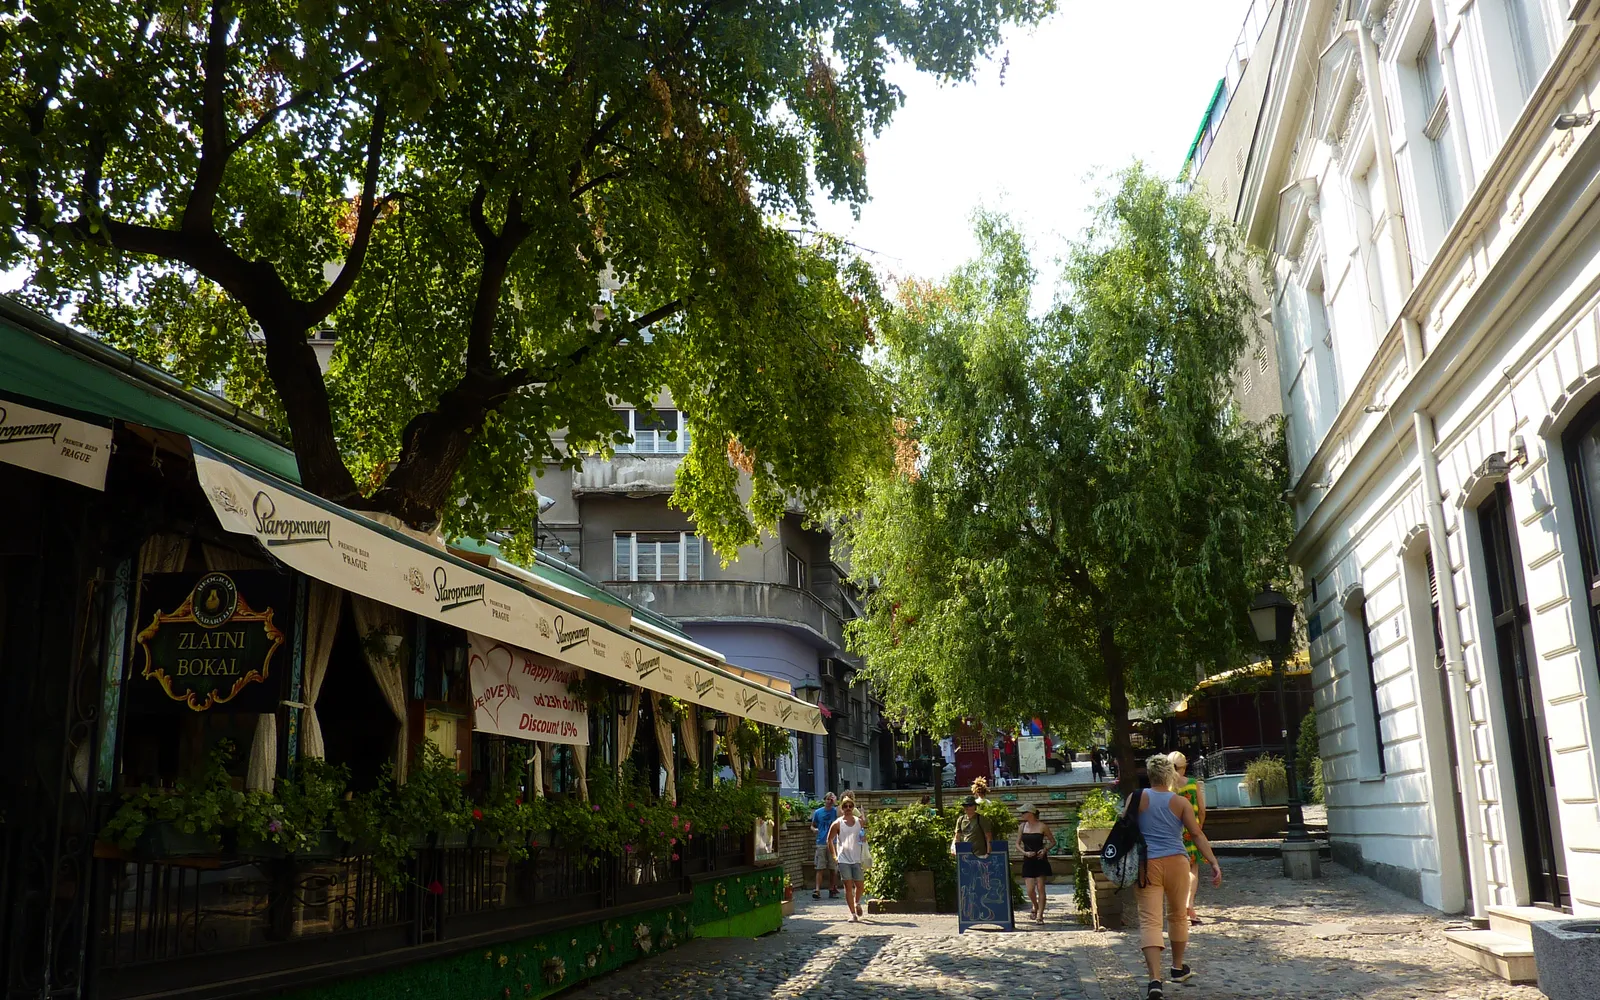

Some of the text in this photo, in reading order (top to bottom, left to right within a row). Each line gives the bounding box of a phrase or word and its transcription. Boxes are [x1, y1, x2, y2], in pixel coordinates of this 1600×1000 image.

[0, 407, 62, 444] ropramen
[60, 446, 92, 463] PRAGUE
[62, 437, 98, 453] PREMIUM BEER
[252, 490, 334, 549] Staropramen
[342, 552, 368, 571] PRAGUE
[197, 576, 234, 591] BEOGRAD
[433, 566, 487, 612] Staropramen
[178, 631, 246, 650] ZLATNI
[176, 658, 241, 676] BOKAL
[522, 657, 554, 684] Happy
[484, 683, 504, 702] LOVE
[504, 683, 520, 701] YOU
[533, 692, 545, 707] od
[545, 694, 561, 709] 23h
[519, 713, 578, 737] Discount 15%
